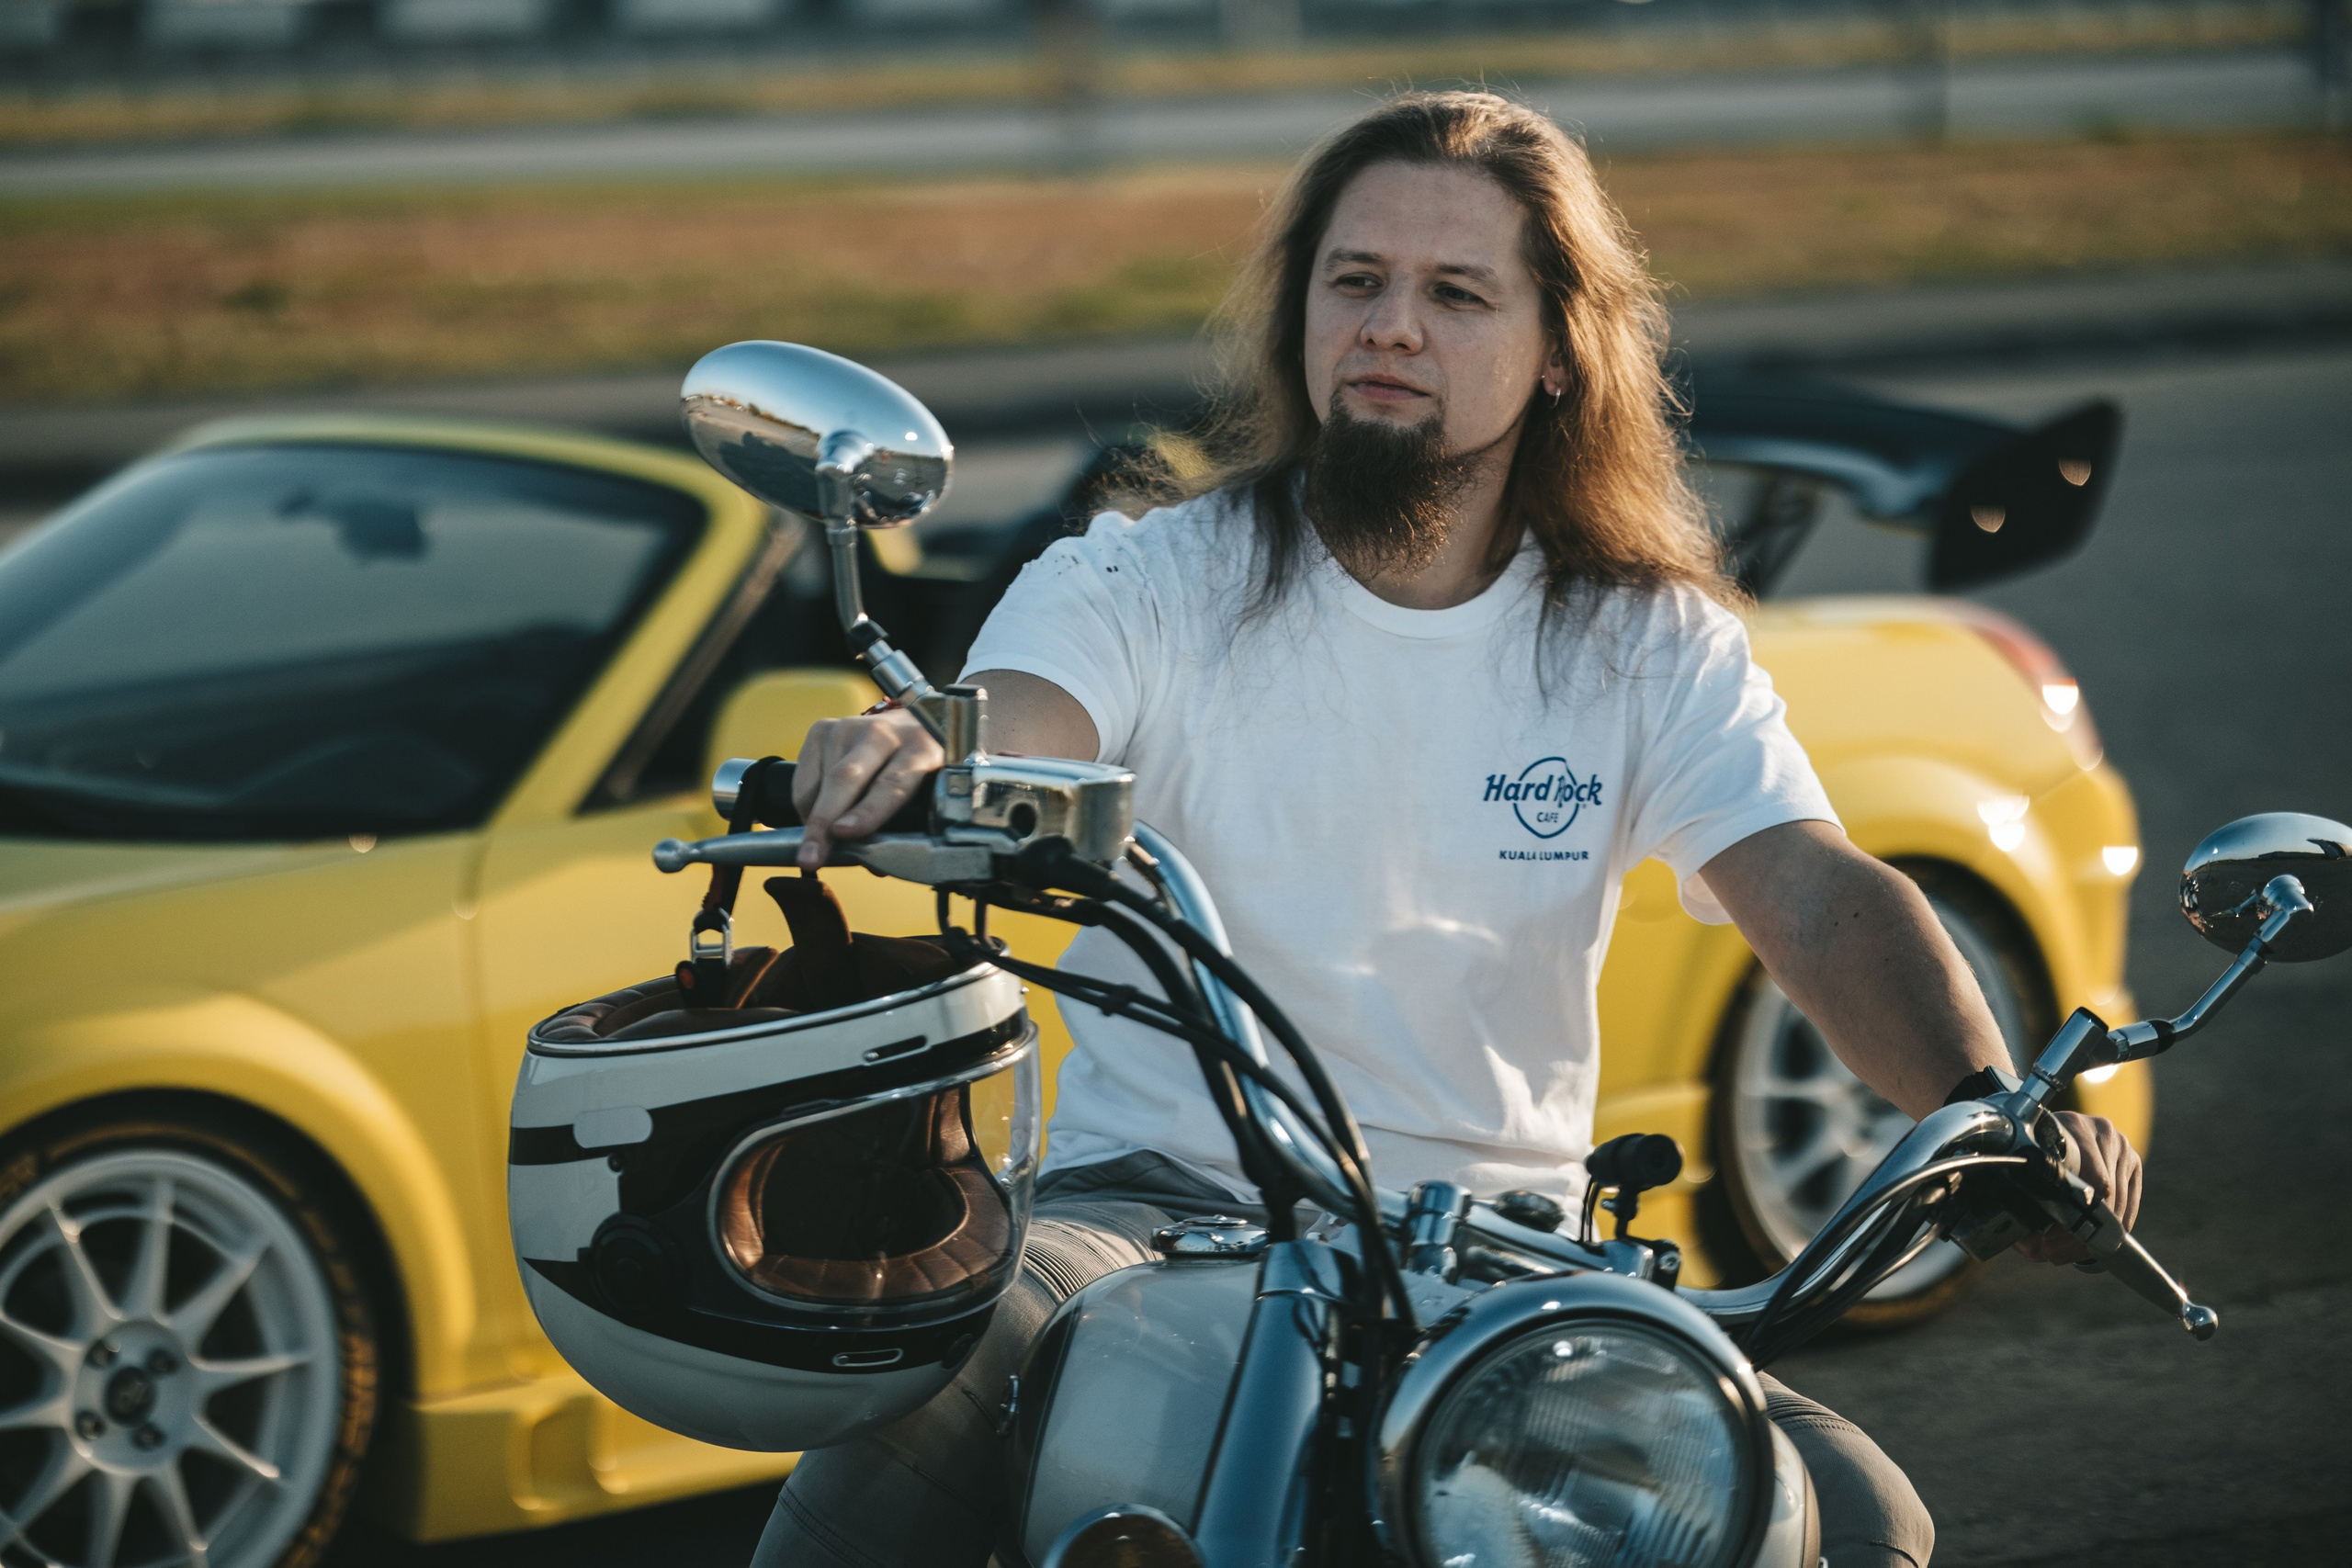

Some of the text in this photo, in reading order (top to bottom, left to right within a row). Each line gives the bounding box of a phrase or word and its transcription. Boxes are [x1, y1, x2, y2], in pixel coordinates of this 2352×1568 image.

[1483, 773, 1554, 801] Hard
[1536, 812, 1559, 823] CAFE
[1499, 851, 1589, 861] KUALA LUMPUR
